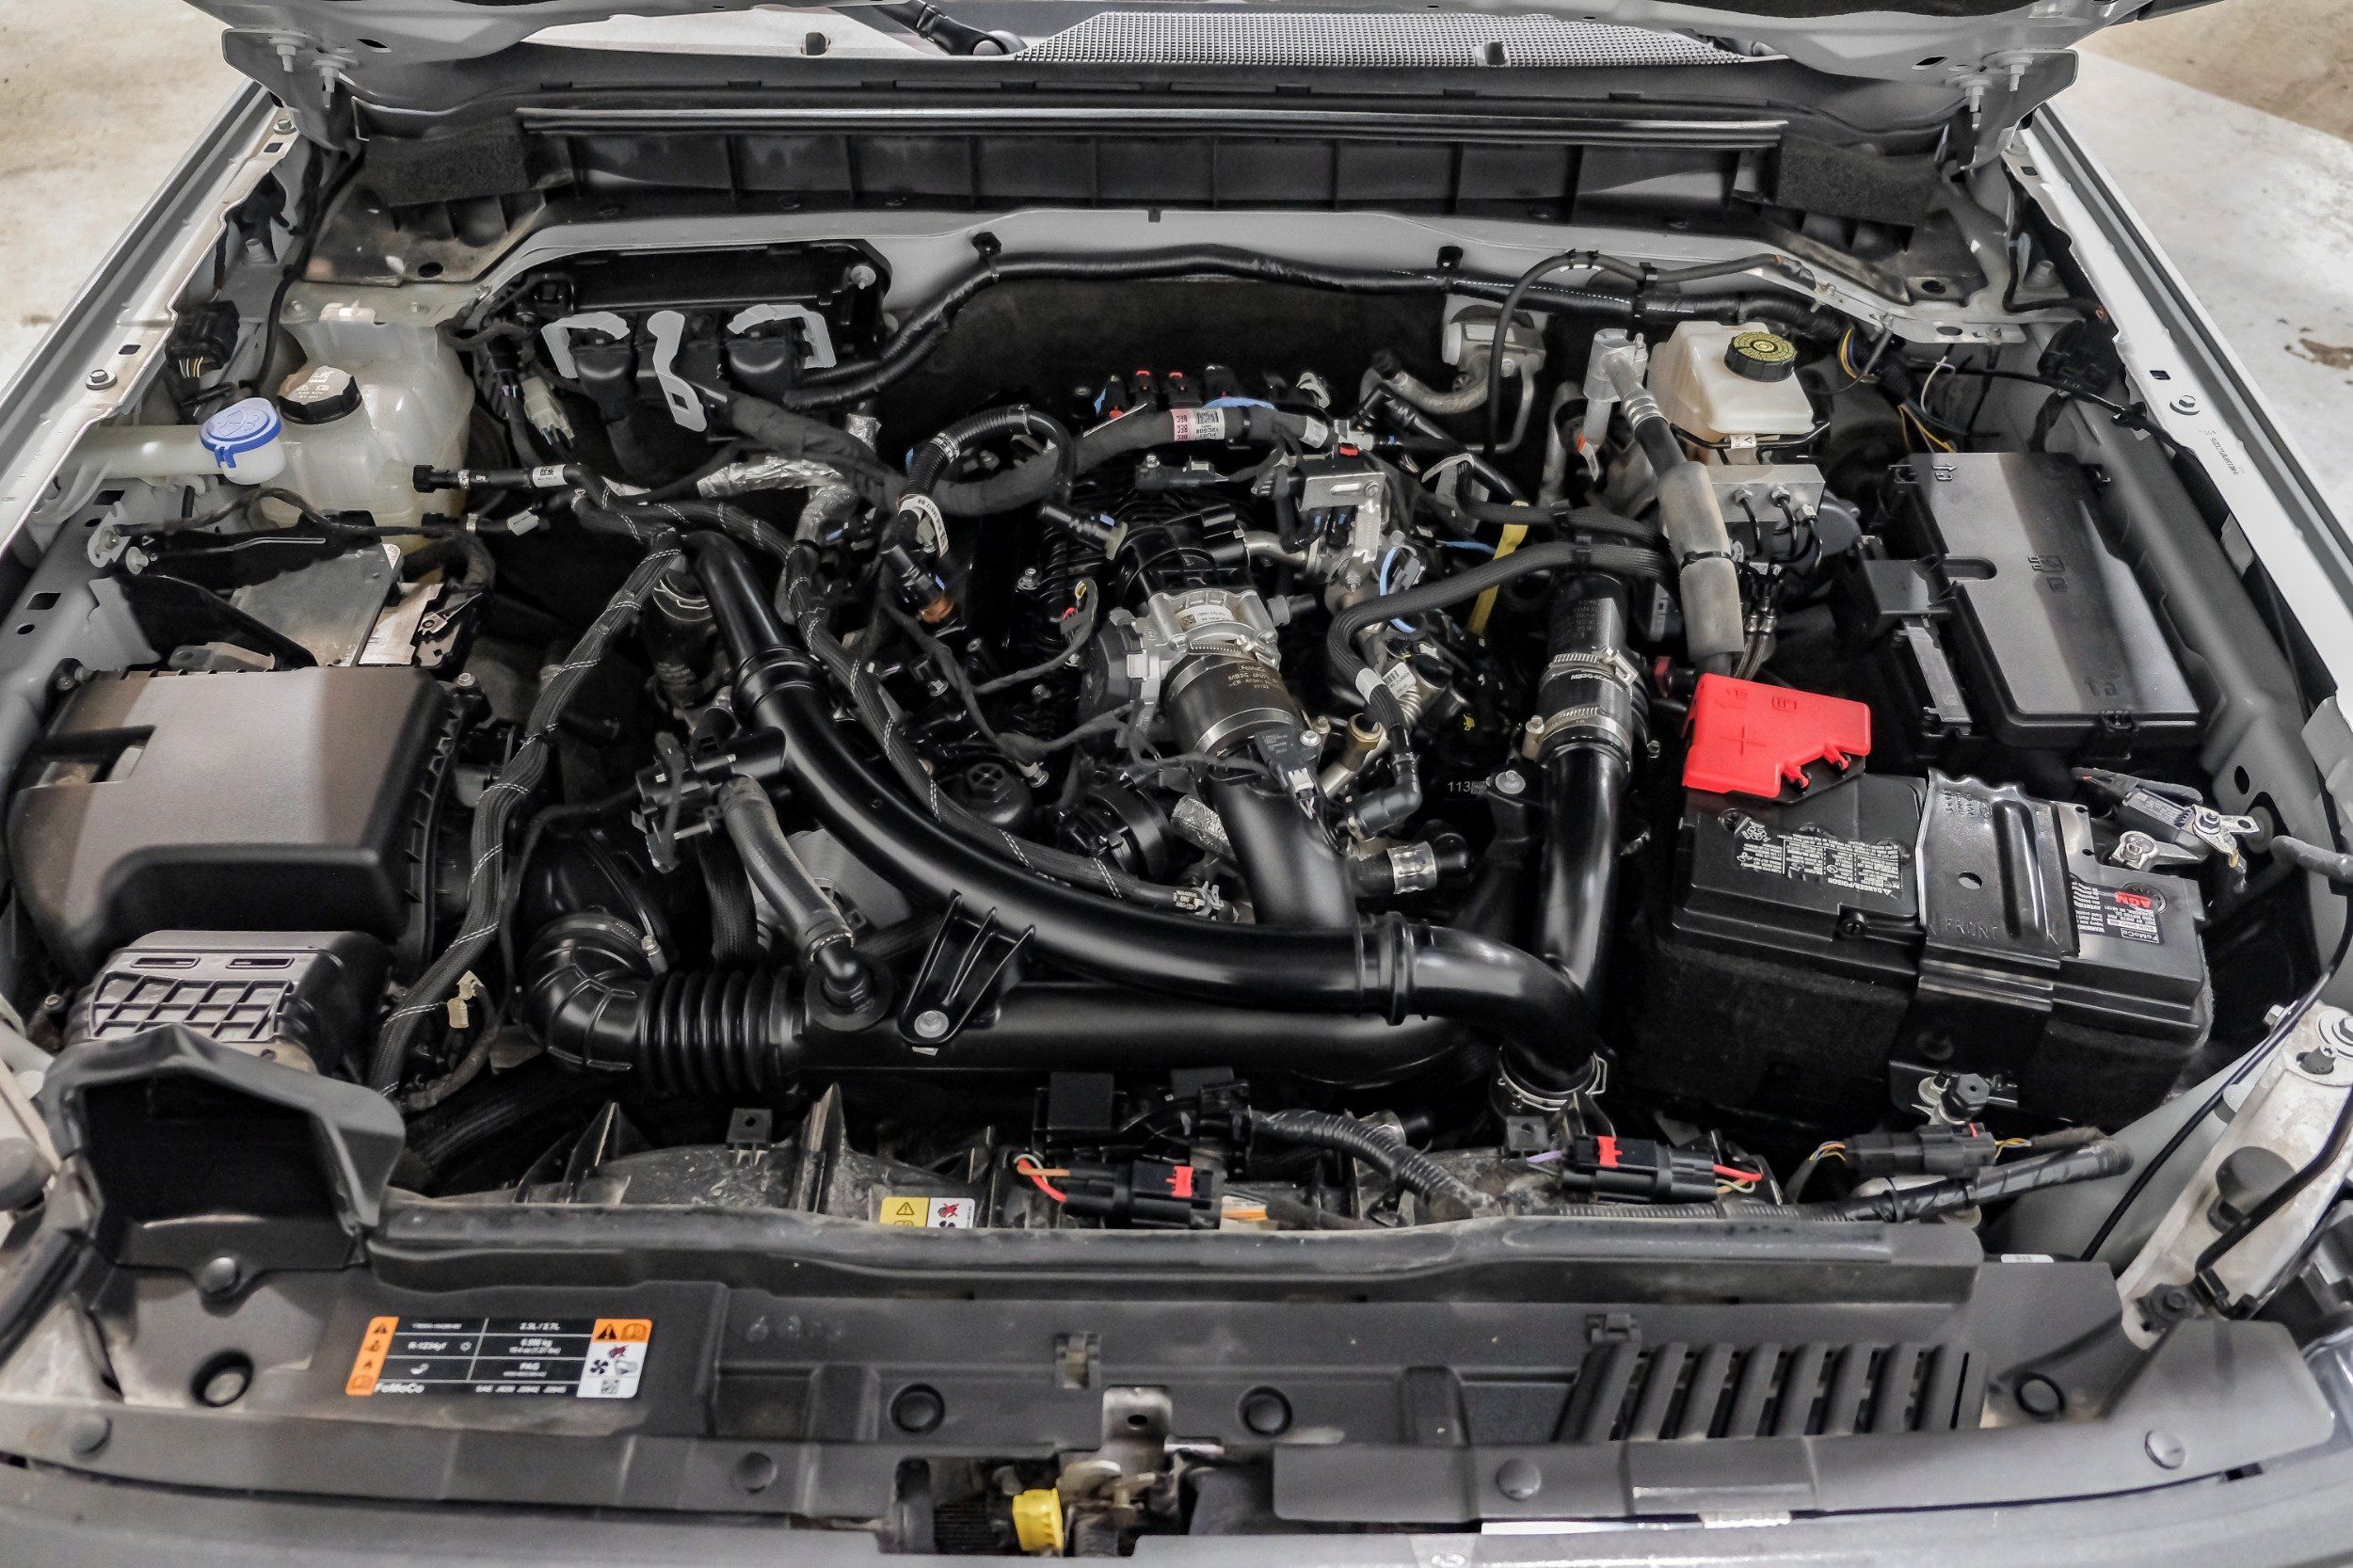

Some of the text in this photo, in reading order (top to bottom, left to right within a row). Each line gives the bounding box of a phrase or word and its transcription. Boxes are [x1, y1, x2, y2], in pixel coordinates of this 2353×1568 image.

[1448, 780, 1471, 792] 113
[1827, 877, 1883, 894] DANGER/POISON
[2115, 896, 2151, 908] AGM
[1945, 918, 1998, 940] FRONT
[2122, 930, 2158, 940] FoMoCo
[374, 1382, 424, 1393] FoMoCo
